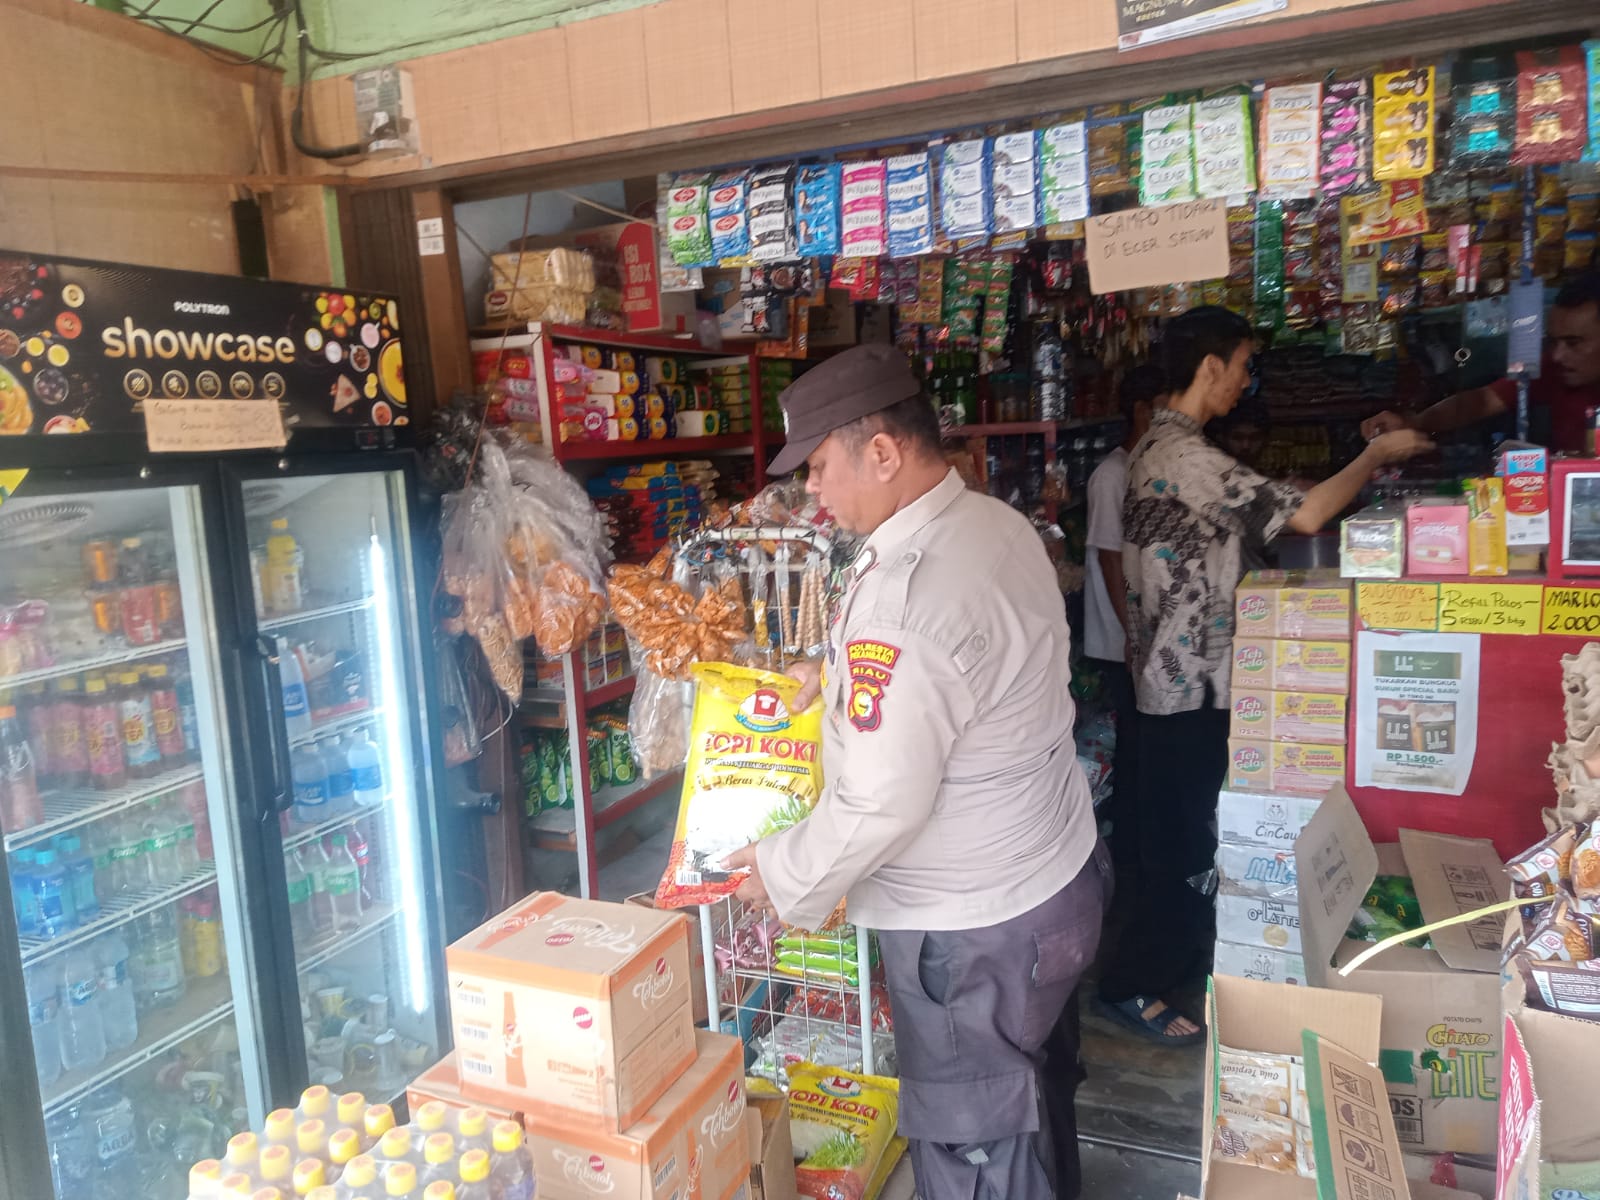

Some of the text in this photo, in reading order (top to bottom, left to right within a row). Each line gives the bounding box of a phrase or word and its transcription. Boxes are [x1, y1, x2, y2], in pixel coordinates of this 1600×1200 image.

[174, 301, 231, 316] POLYTRON
[101, 316, 296, 363] showcase
[1246, 598, 1265, 610] Teh
[1242, 648, 1262, 660] Teh
[852, 667, 886, 681] RIAU
[1241, 699, 1261, 711] Teh
[759, 736, 818, 763] KOKI
[1239, 749, 1260, 761] Teh
[1386, 752, 1402, 761] RP
[1260, 1070, 1280, 1081] Gula
[789, 1090, 828, 1106] TOPI
[830, 1098, 879, 1121] KOKI
